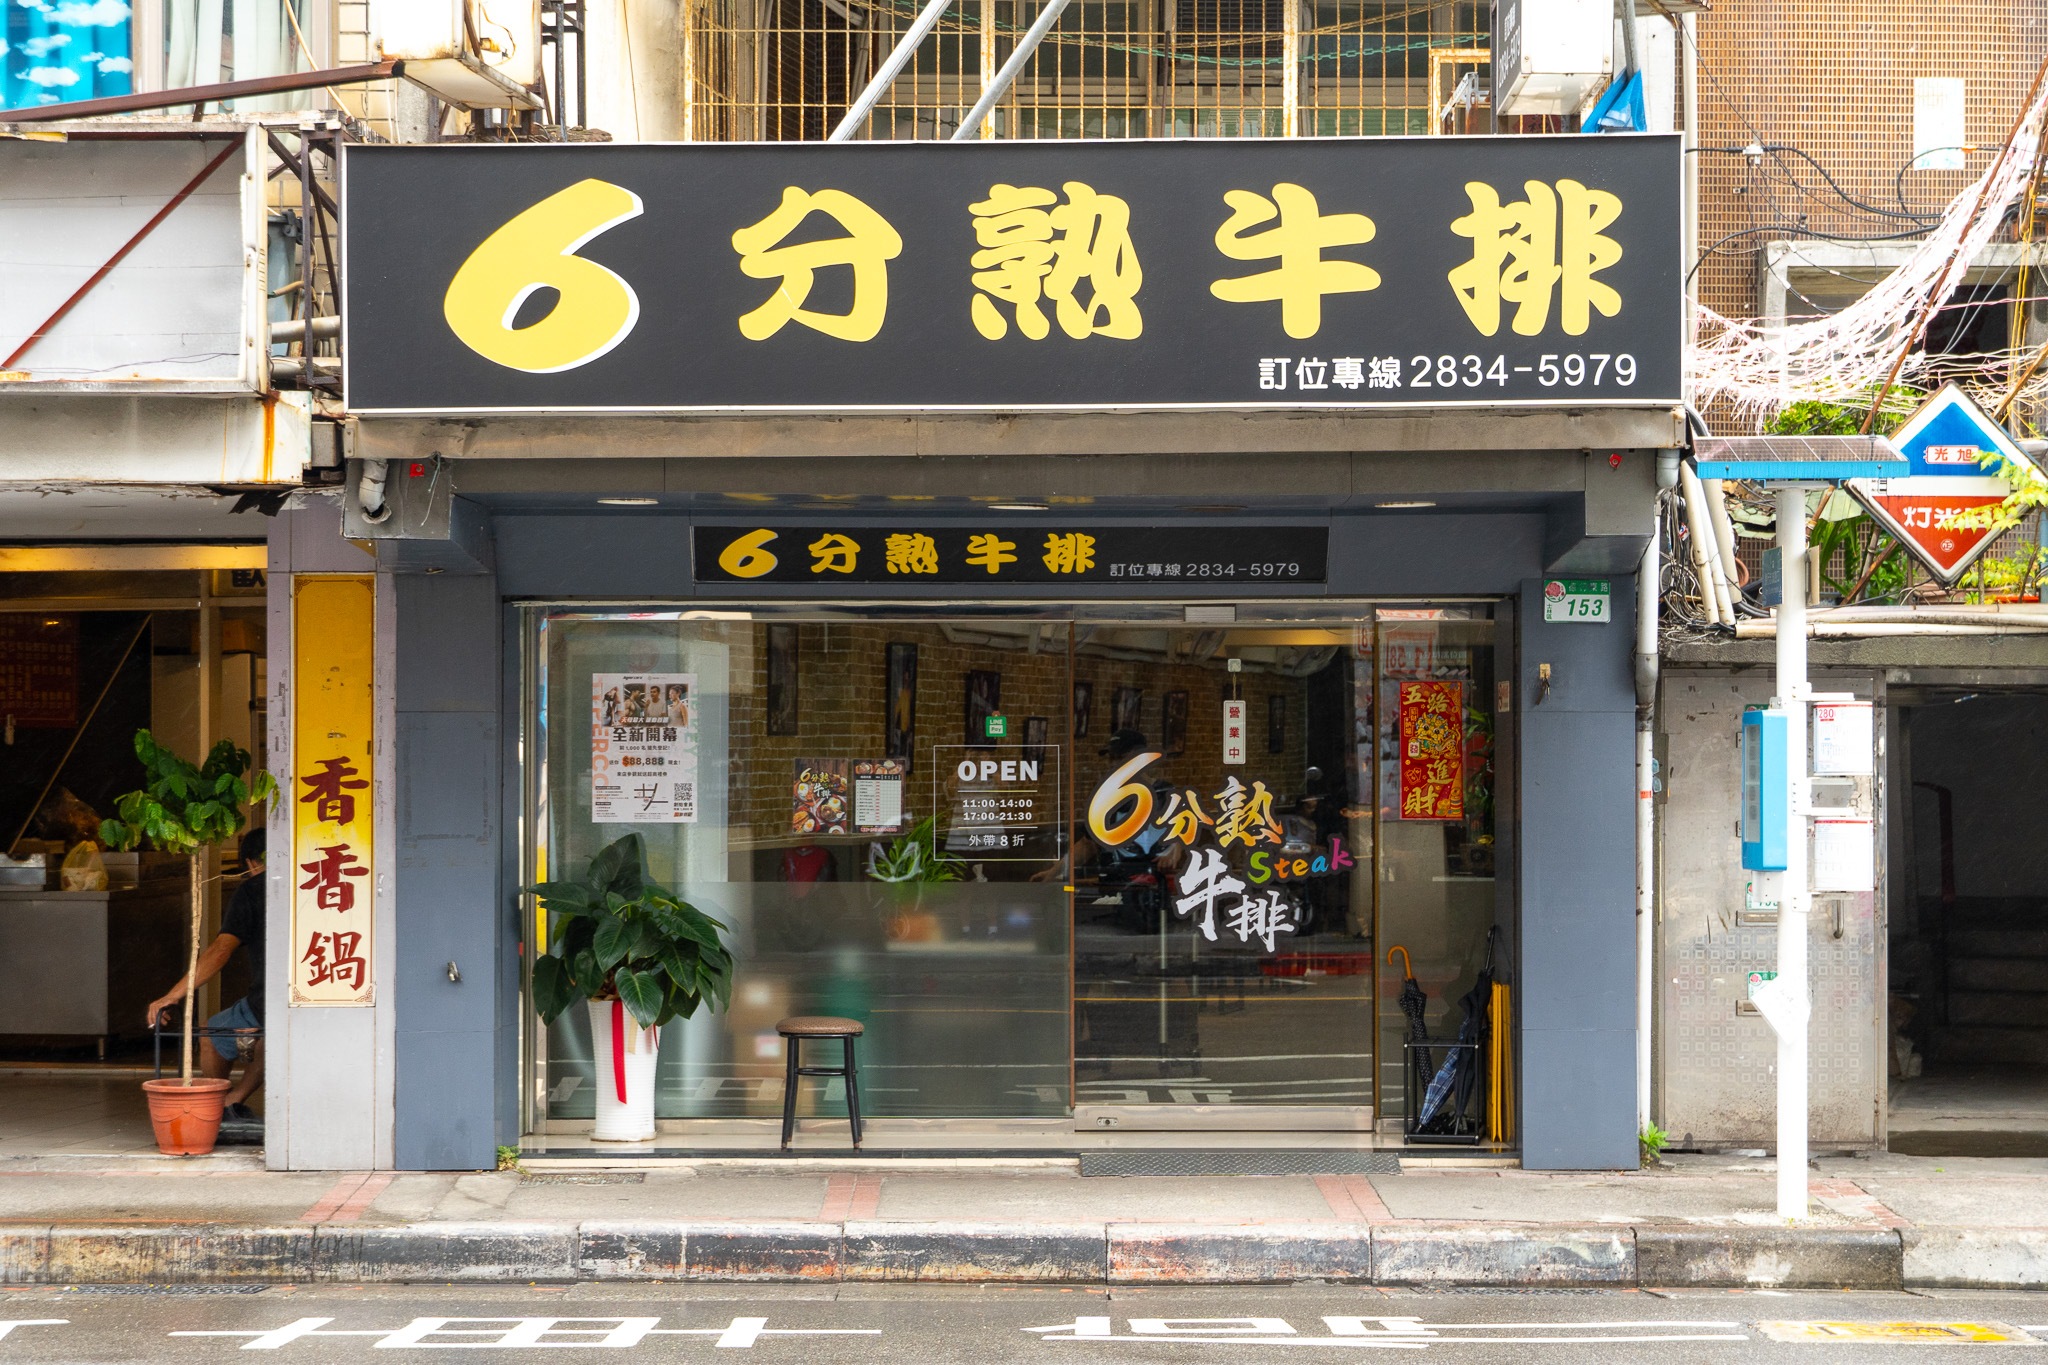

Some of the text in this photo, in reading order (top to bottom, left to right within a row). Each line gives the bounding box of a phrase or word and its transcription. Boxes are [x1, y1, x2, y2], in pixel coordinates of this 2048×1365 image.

[443, 177, 1624, 375] 6分熟牛排
[1258, 352, 1637, 391] 訂位專線 2834-5979
[718, 528, 1096, 578] 6分熟牛排
[1109, 563, 1300, 577] 訂位專線 2834-5979
[1567, 598, 1603, 617] 153
[612, 727, 678, 743] 全新開幕
[1229, 706, 1241, 759] 營業中
[622, 756, 665, 767] $88,888
[957, 760, 1038, 781] OPEN
[962, 799, 1033, 808] 11:00-14:00
[1088, 752, 1284, 848] 6分熟
[963, 811, 1032, 821] 17:00-21:30
[969, 834, 1025, 847] 外帶 8 折
[300, 756, 370, 992] 香香鍋
[1247, 838, 1353, 883] Steak
[1176, 848, 1296, 953] 牛排
